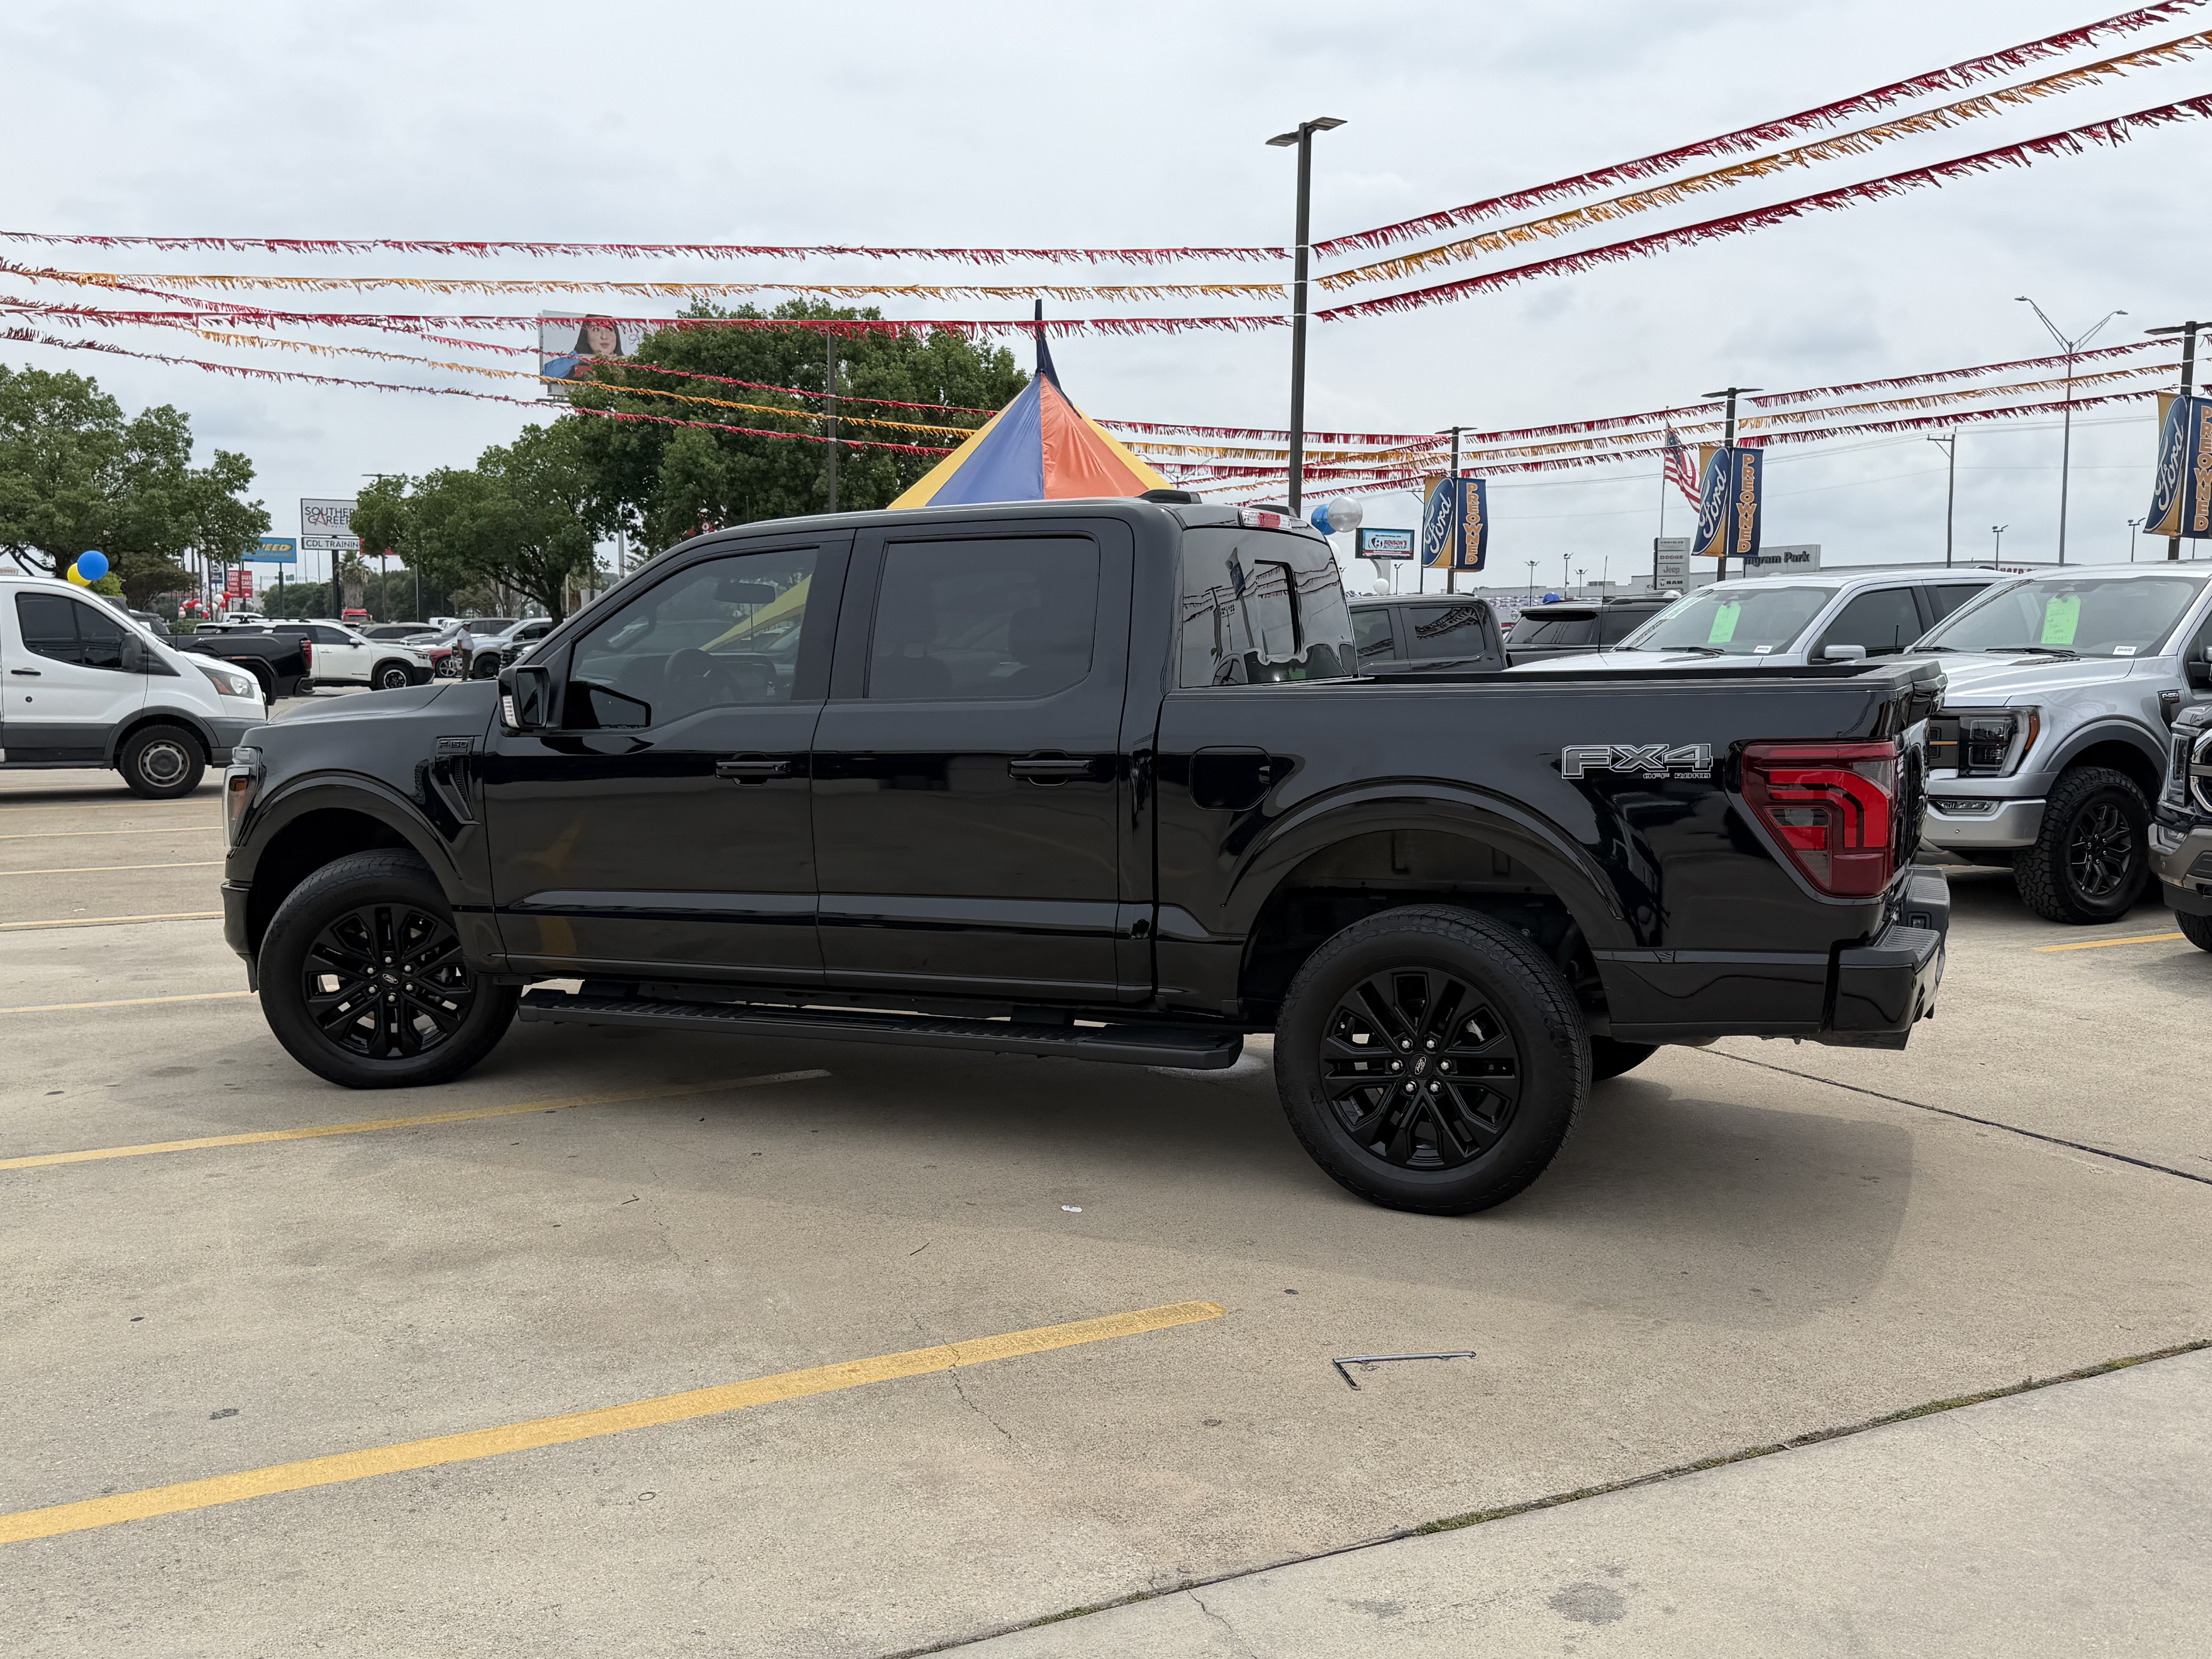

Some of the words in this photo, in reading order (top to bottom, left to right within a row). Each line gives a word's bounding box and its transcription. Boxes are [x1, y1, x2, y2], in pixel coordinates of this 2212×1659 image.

[2155, 417, 2183, 511] Ford
[1425, 493, 1451, 554] Ford
[1698, 464, 1726, 538] Ford
[1664, 565, 1680, 574] Jeep
[1784, 551, 1810, 562] Park
[1562, 744, 1713, 779] FX4
